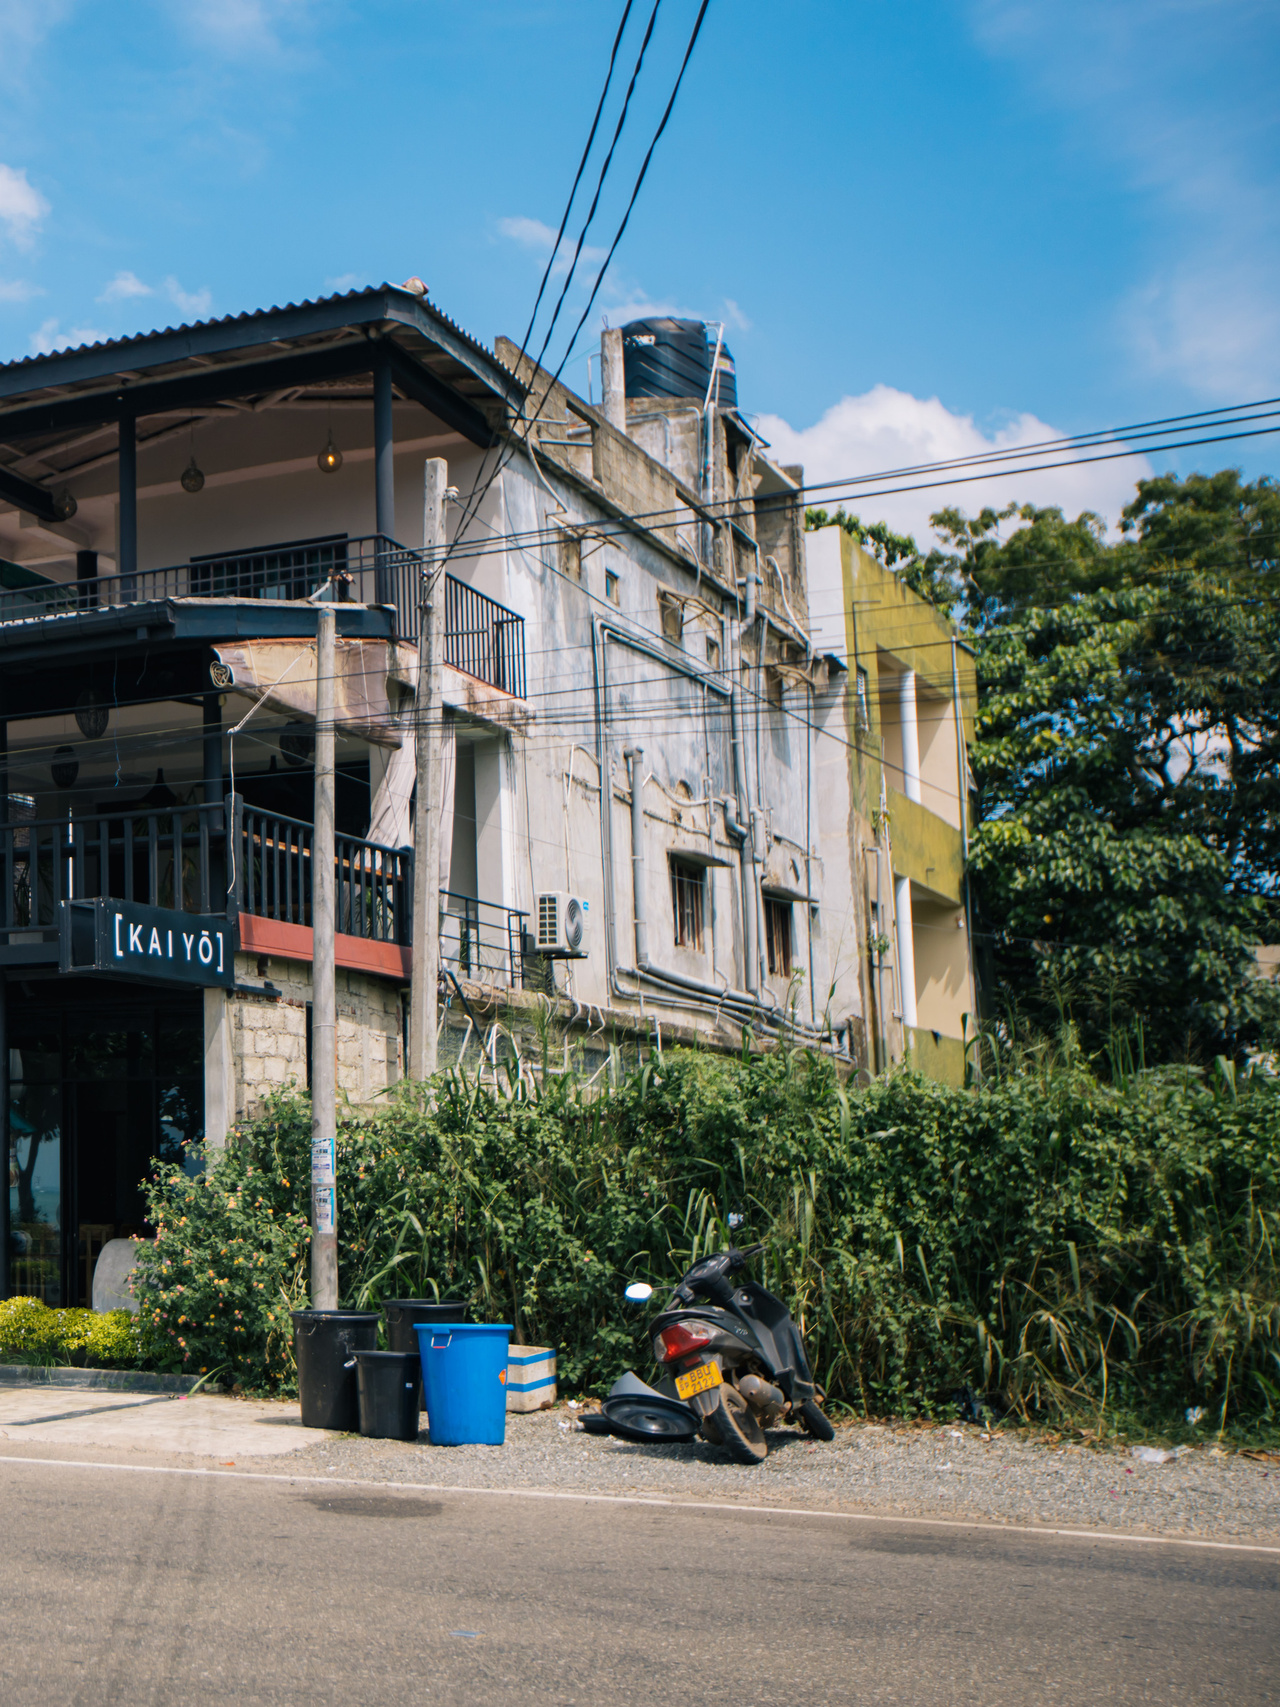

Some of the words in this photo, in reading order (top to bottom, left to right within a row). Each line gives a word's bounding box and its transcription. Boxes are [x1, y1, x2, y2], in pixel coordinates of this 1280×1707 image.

[689, 1363, 711, 1382] BBU
[679, 1382, 689, 1391] SP
[691, 1376, 715, 1393] 2122
